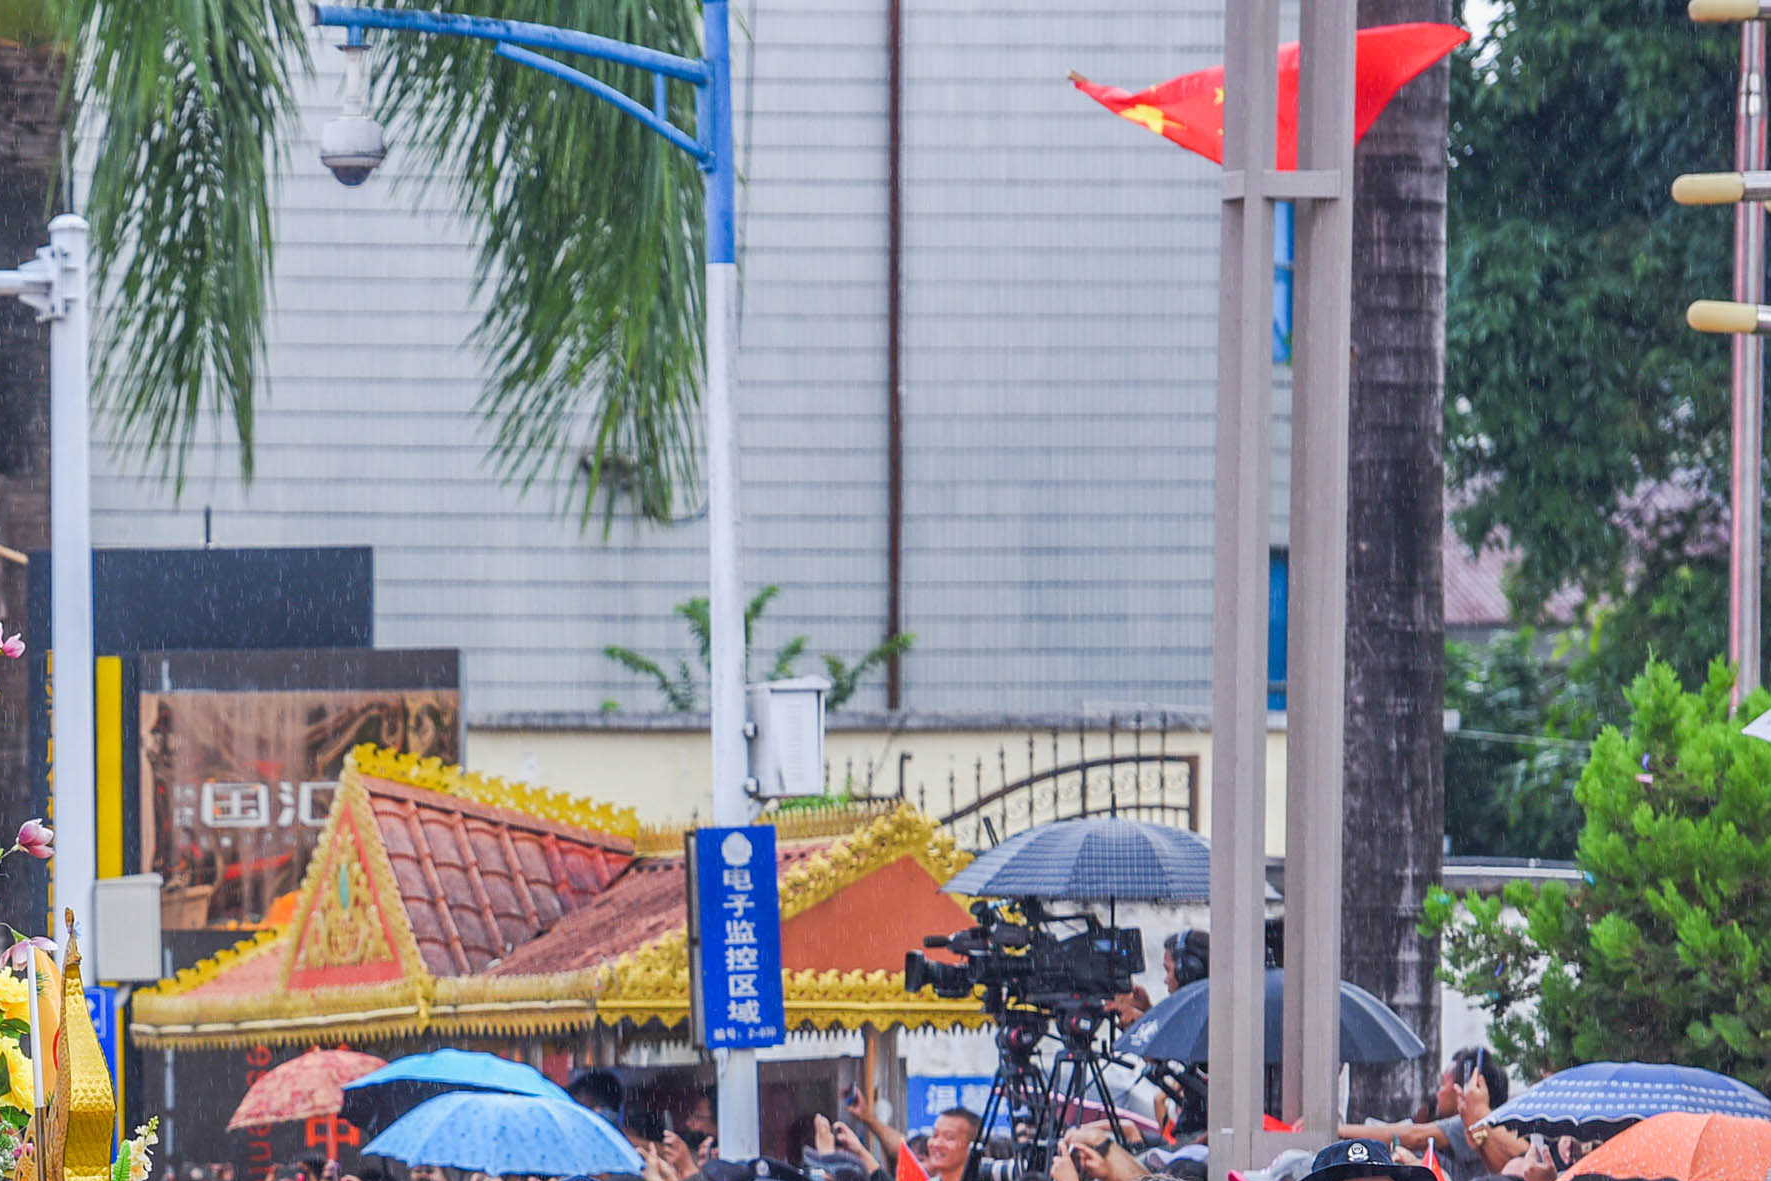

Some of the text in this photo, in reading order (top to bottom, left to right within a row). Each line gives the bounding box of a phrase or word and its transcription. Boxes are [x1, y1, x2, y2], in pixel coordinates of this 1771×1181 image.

[722, 868, 762, 1025] 电子监控区域
